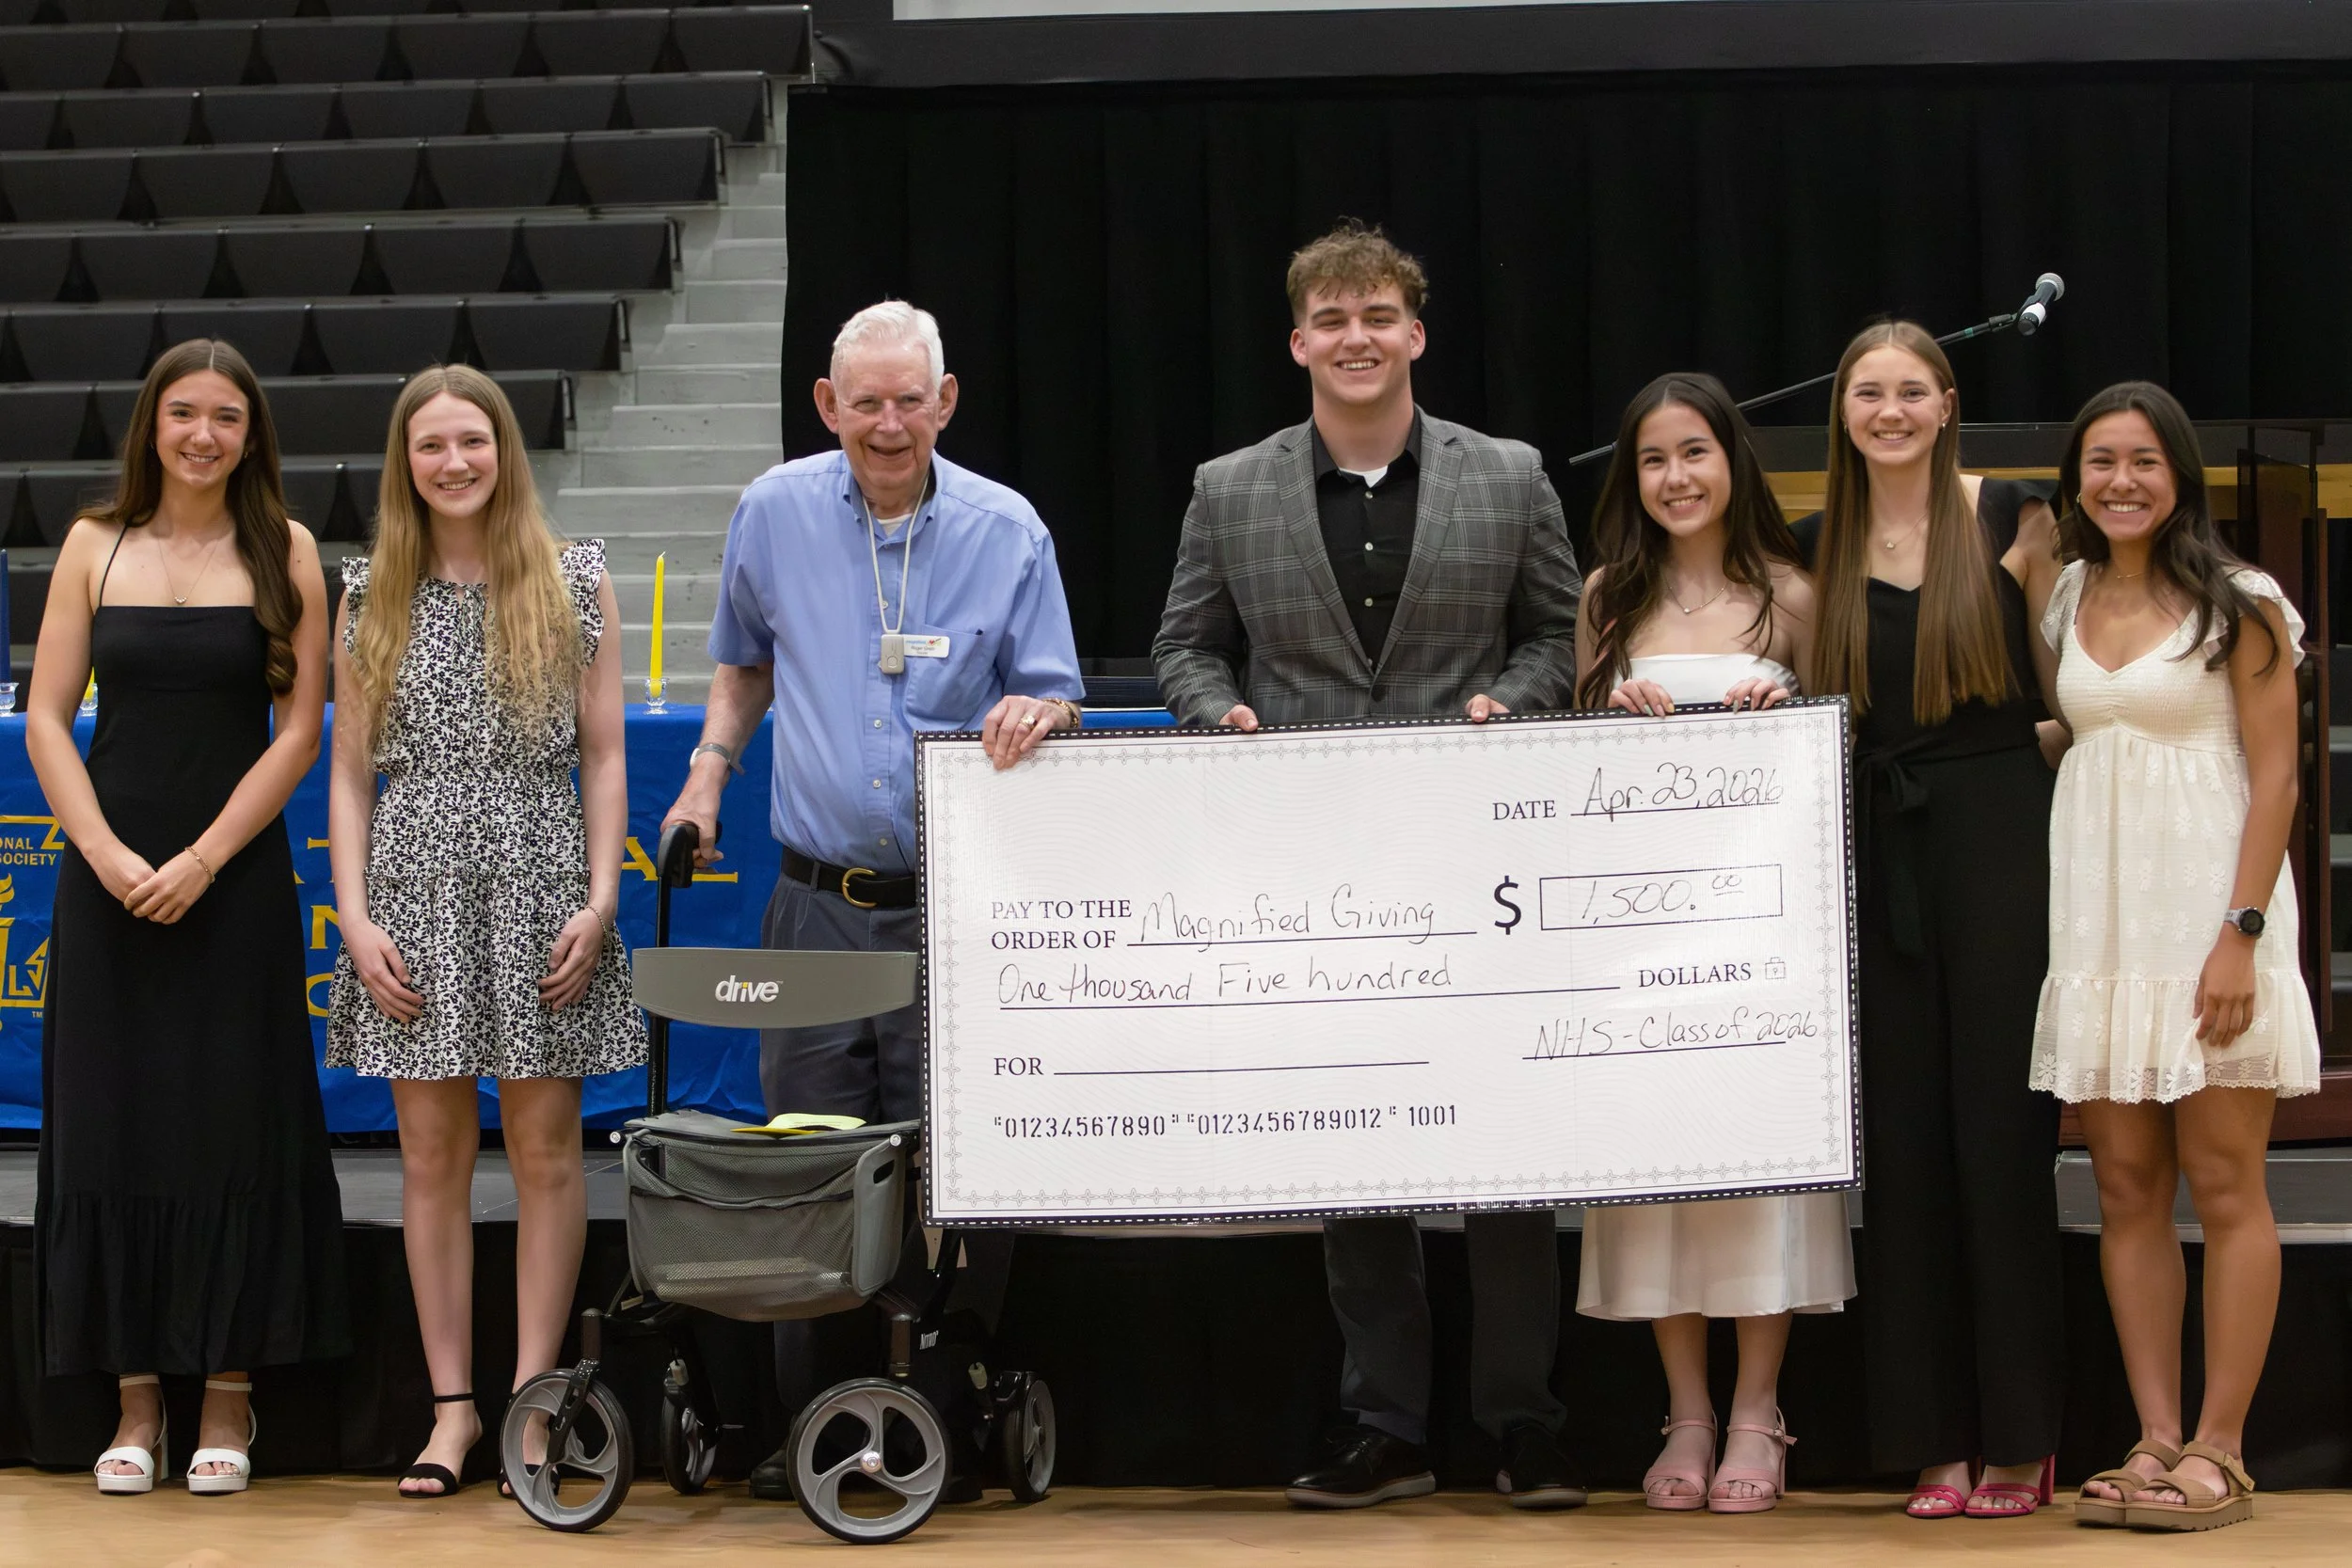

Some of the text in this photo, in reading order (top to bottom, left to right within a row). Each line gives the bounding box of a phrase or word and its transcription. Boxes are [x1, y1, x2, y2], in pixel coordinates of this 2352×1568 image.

[1492, 800, 1557, 820] DATE
[0, 852, 56, 865] OCIETY
[992, 899, 1132, 920] PAY TO THE
[1494, 875, 1522, 935] $
[1141, 883, 1434, 952] Magnified Giving
[992, 930, 1117, 950] ORDER OF
[998, 954, 1452, 1004] One thousand Five hundred
[1638, 962, 1752, 988] DOLLARS
[715, 974, 779, 1003] drive
[1756, 1011, 1818, 1041] 2026
[993, 1057, 1044, 1076] FOR
[1408, 1104, 1456, 1127] 1001
